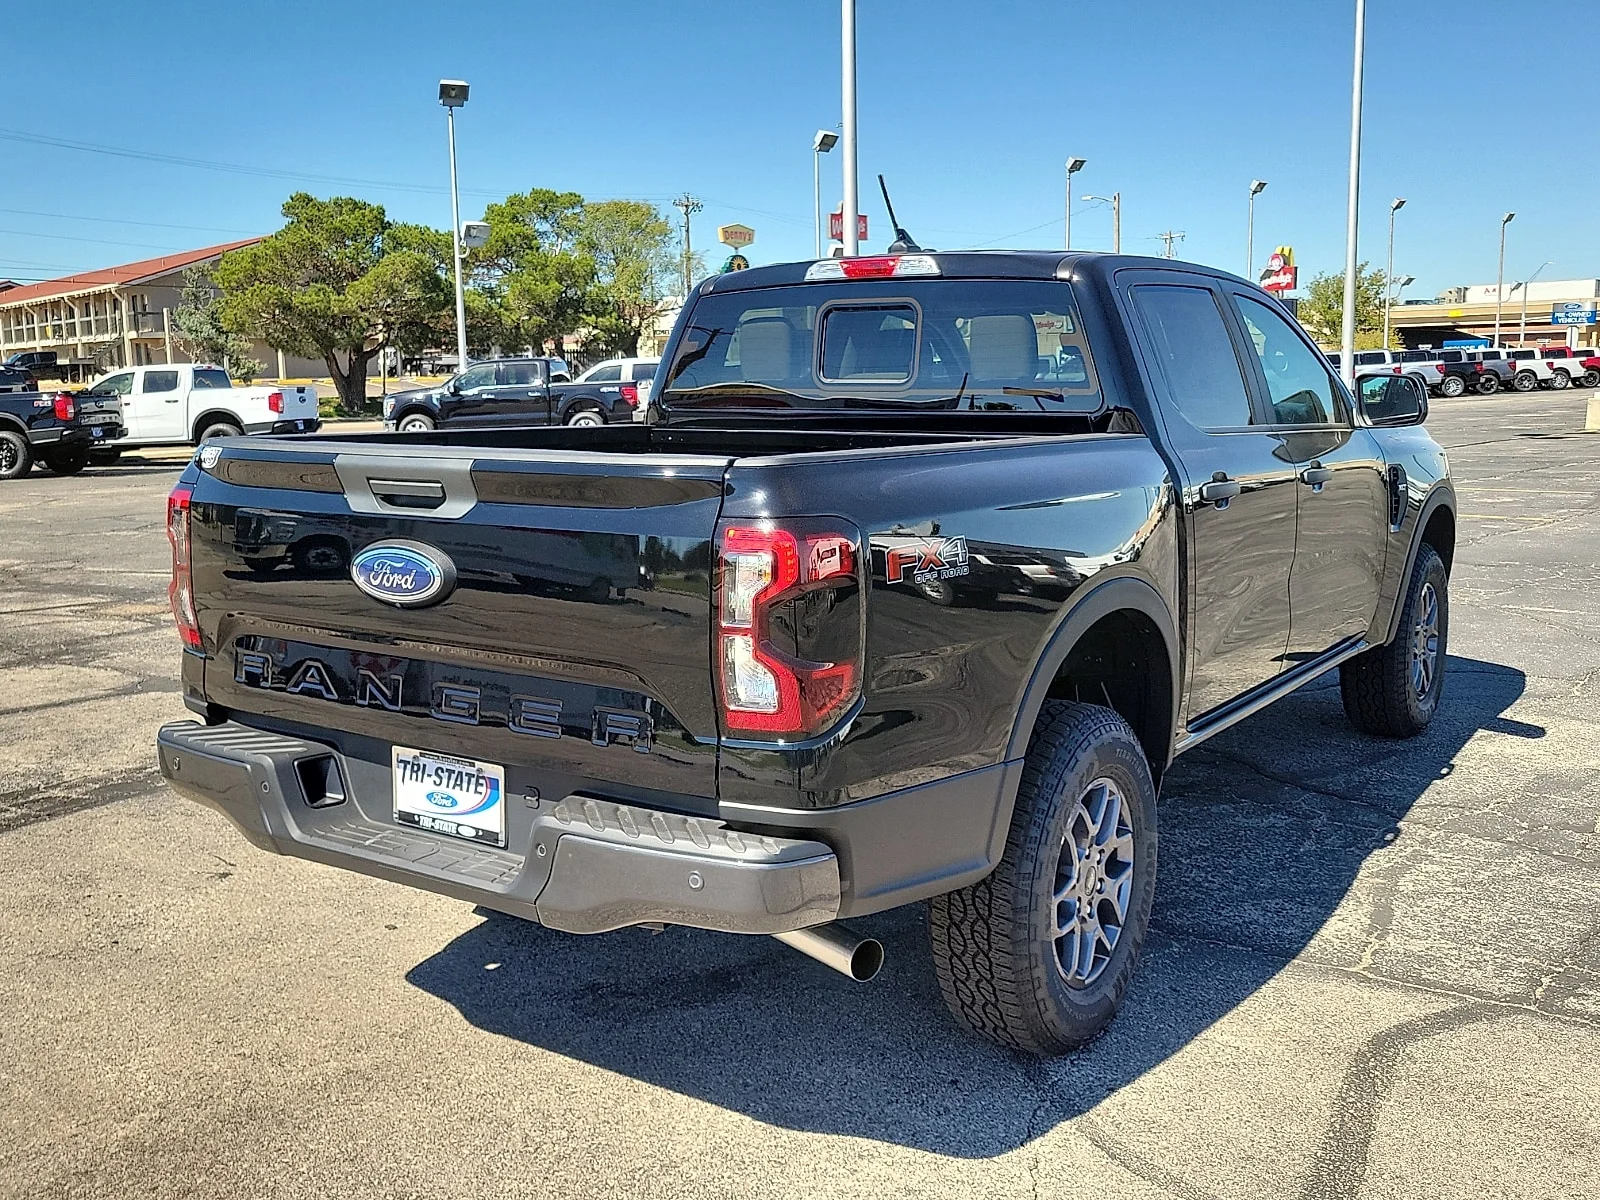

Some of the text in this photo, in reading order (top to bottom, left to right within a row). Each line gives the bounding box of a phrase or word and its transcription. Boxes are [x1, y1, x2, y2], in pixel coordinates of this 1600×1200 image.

[369, 558, 417, 590] Ford
[885, 535, 969, 585] FX4
[914, 565, 970, 584] OFF ROAD
[233, 648, 654, 754] RANGER
[397, 757, 487, 796] TRI-STATE
[430, 790, 455, 808] Ford
[419, 815, 459, 835] TRI-STATE
